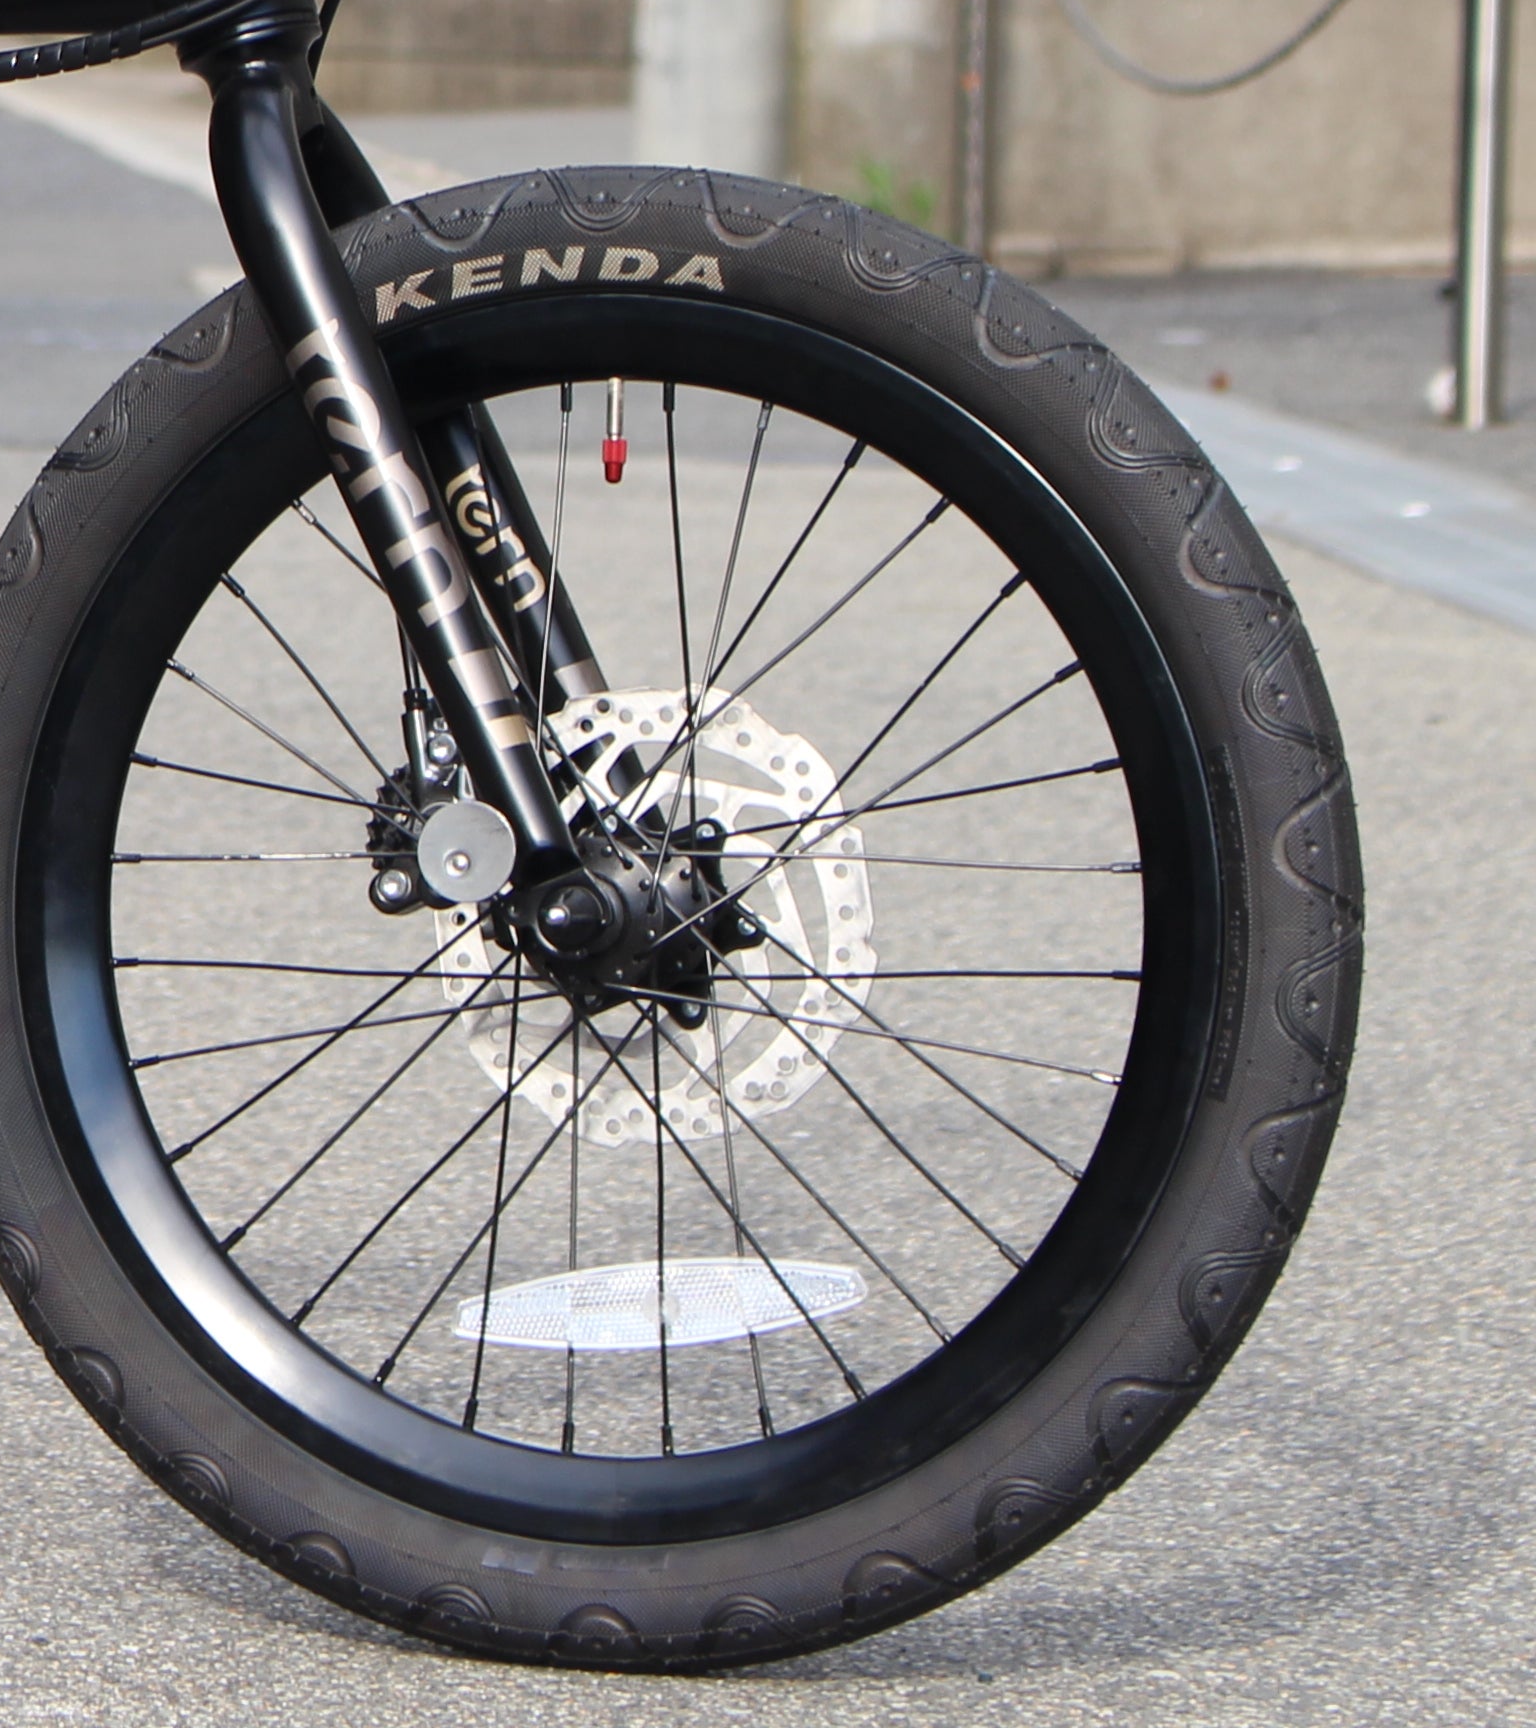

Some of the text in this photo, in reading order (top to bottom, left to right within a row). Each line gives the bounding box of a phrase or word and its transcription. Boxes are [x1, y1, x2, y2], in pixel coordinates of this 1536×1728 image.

[374, 246, 726, 325] KENDA
[285, 318, 470, 628] tern
[445, 462, 546, 613] tern
